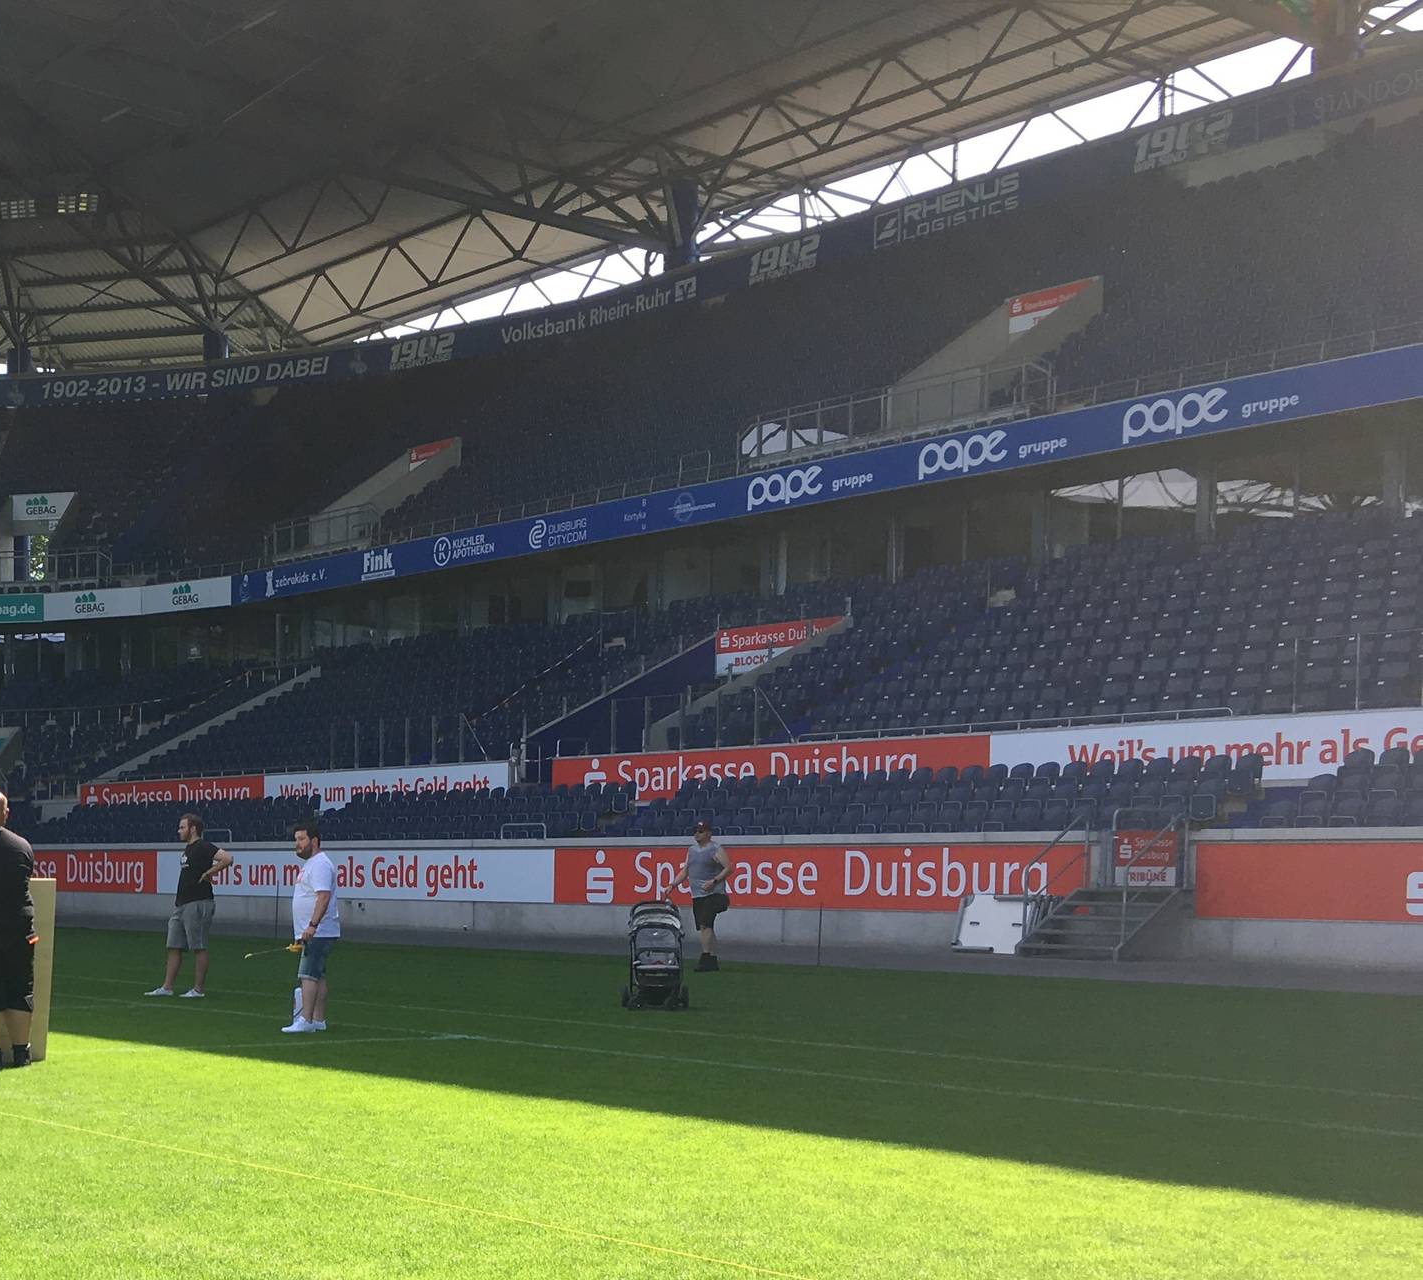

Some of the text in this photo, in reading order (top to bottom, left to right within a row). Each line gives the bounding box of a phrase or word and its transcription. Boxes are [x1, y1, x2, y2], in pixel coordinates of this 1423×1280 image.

[1136, 108, 1233, 161] 192
[904, 172, 1020, 223] RHENUS
[902, 195, 1020, 240] LOGISTICS
[501, 286, 671, 344] Volksbank Rhein-Ruhr
[42, 378, 146, 399] 1902-2013
[166, 373, 207, 391] WIR
[212, 364, 262, 387] SIND
[266, 356, 329, 381] DABEI
[1122, 387, 1300, 444] pape gruppe
[918, 430, 1068, 480] pape gruppe
[747, 465, 873, 511] pape gruppe
[26, 506, 56, 515] GEBAG
[548, 518, 587, 535] DUISBURG
[548, 530, 587, 547] CITYCOM
[363, 548, 393, 573] Fink
[452, 543, 495, 559] APOTHEKEN
[275, 573, 309, 589] zebrakids
[75, 603, 105, 613] GEBAG
[172, 594, 198, 605] GEBAG
[732, 631, 785, 648] Sparkasse
[735, 655, 765, 666] BLOCK
[1227, 732, 1311, 765] mehr
[1320, 729, 1369, 763] als
[102, 785, 172, 807] Sparkasse
[325, 786, 345, 802] um
[67, 854, 144, 892] Duisburg
[249, 864, 275, 886] um
[337, 856, 365, 887] als
[371, 855, 417, 889] Geld
[425, 856, 484, 897] geht.
[634, 847, 1048, 900] Spasse Duisburg
[1128, 869, 1166, 881] RIBÜNE
